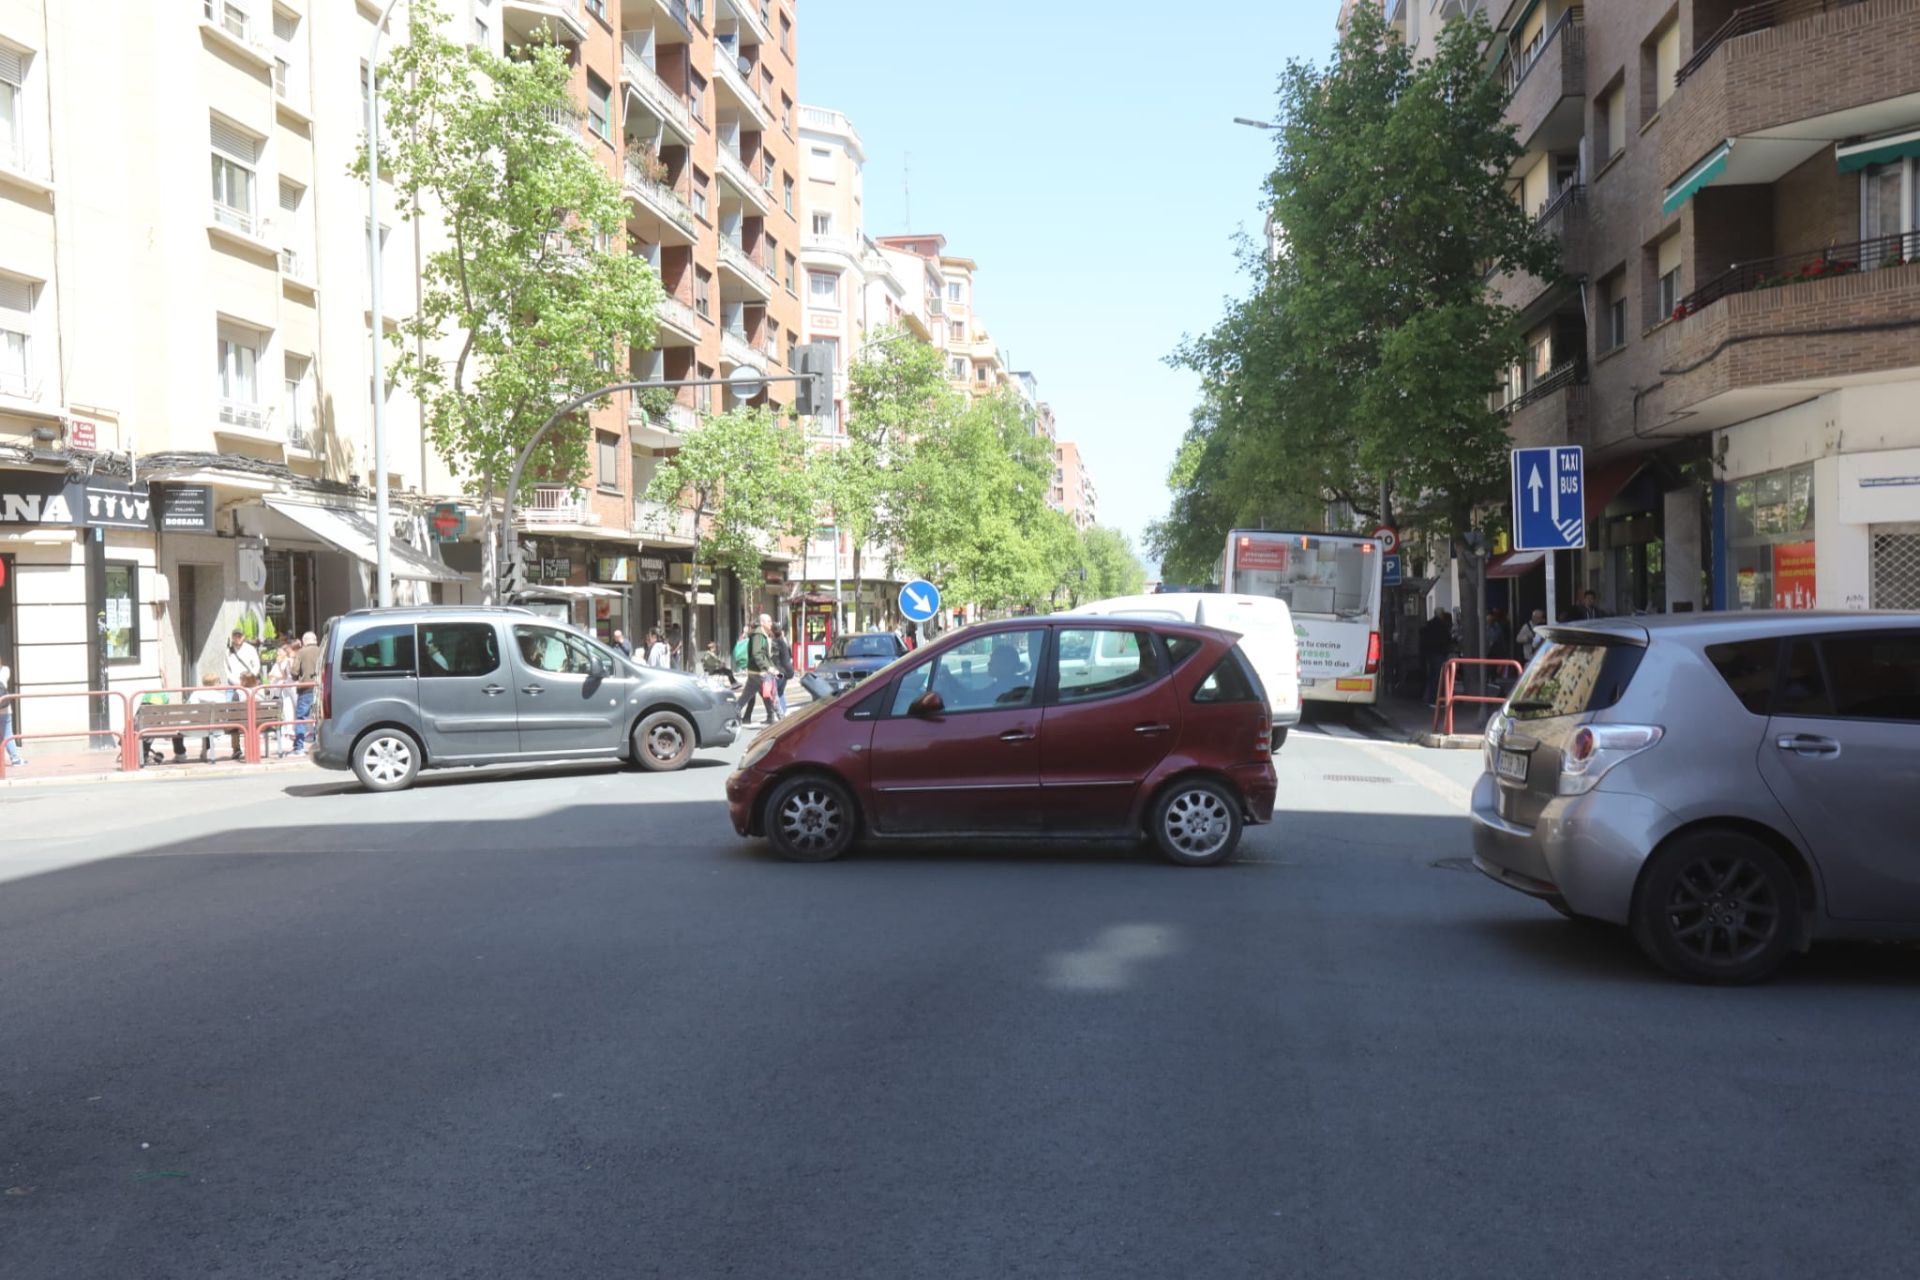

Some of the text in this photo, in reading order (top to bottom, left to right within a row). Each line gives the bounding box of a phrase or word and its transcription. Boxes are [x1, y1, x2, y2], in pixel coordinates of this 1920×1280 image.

[1560, 453, 1579, 472] TAXI
[1560, 475, 1579, 494] BUS
[0, 494, 73, 522] NA
[1315, 641, 1341, 649] cocina
